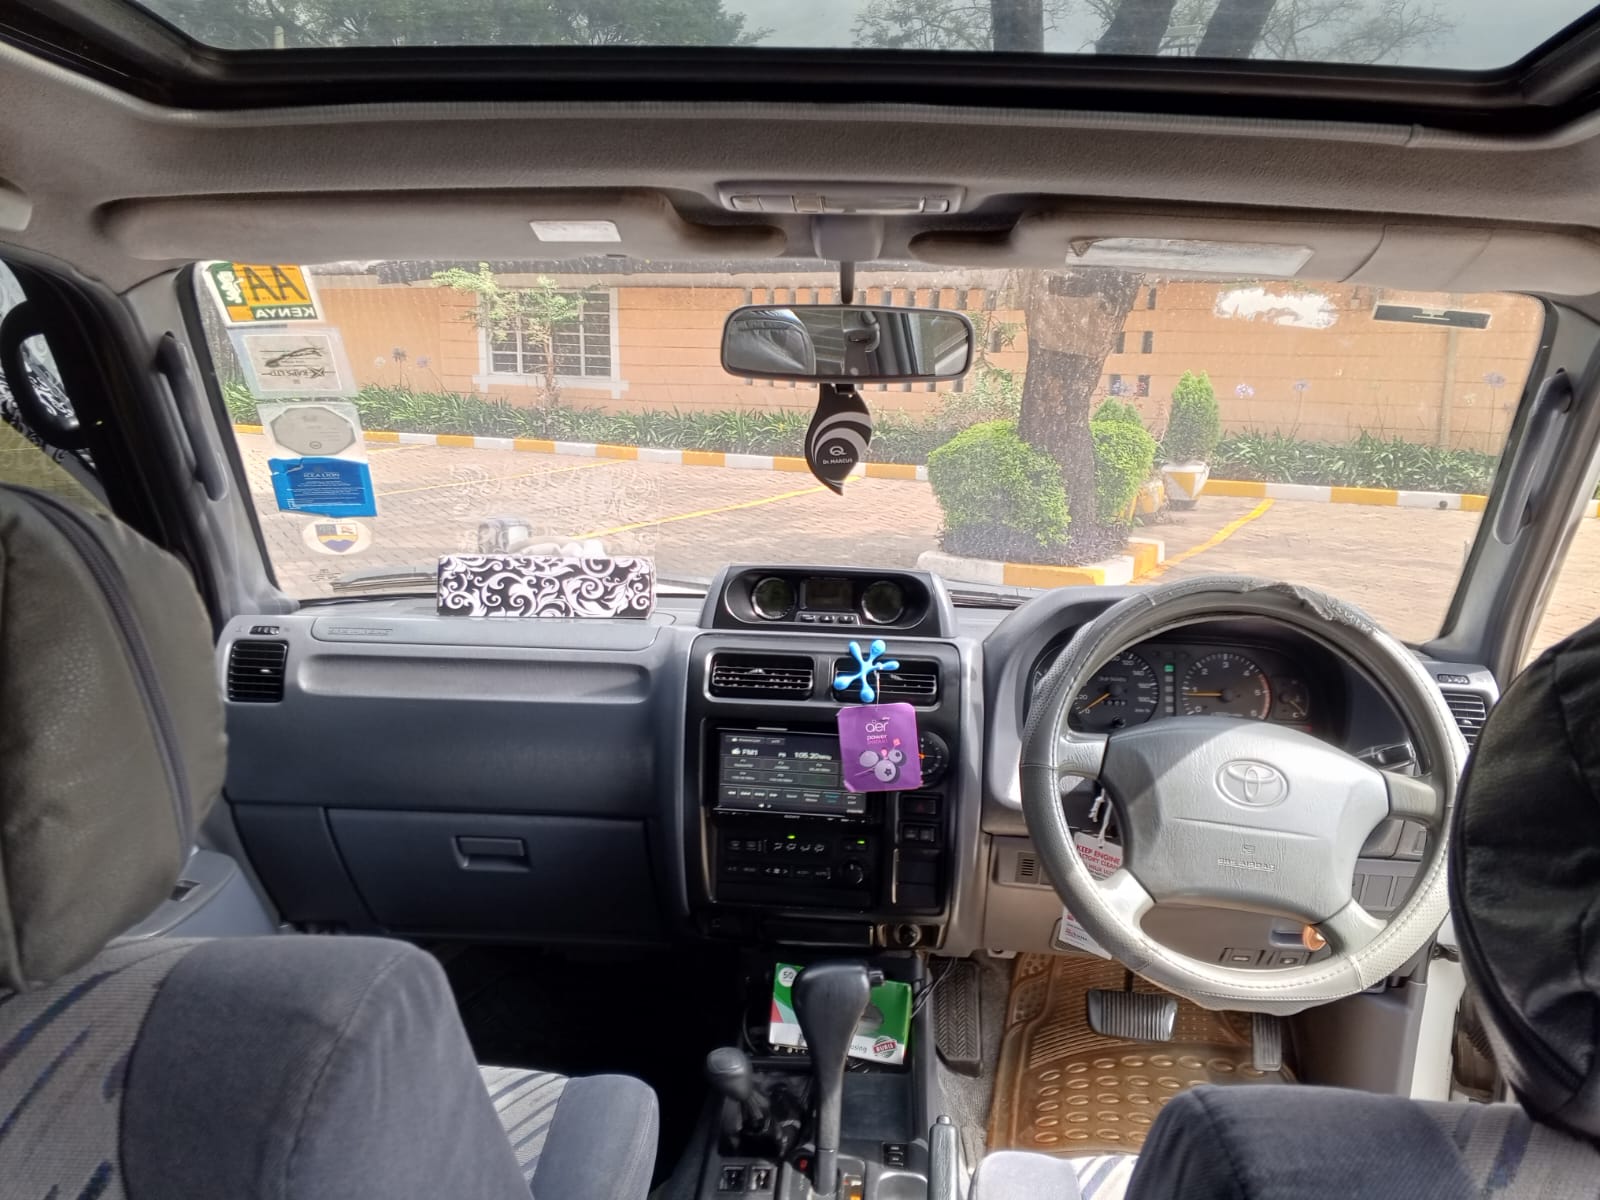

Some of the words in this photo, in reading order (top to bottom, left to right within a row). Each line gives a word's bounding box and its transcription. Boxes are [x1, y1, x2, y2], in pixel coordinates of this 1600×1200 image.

[1076, 844, 1093, 854] KEEP
[1094, 850, 1121, 864] ENGINE
[1077, 852, 1100, 864] ACTORY
